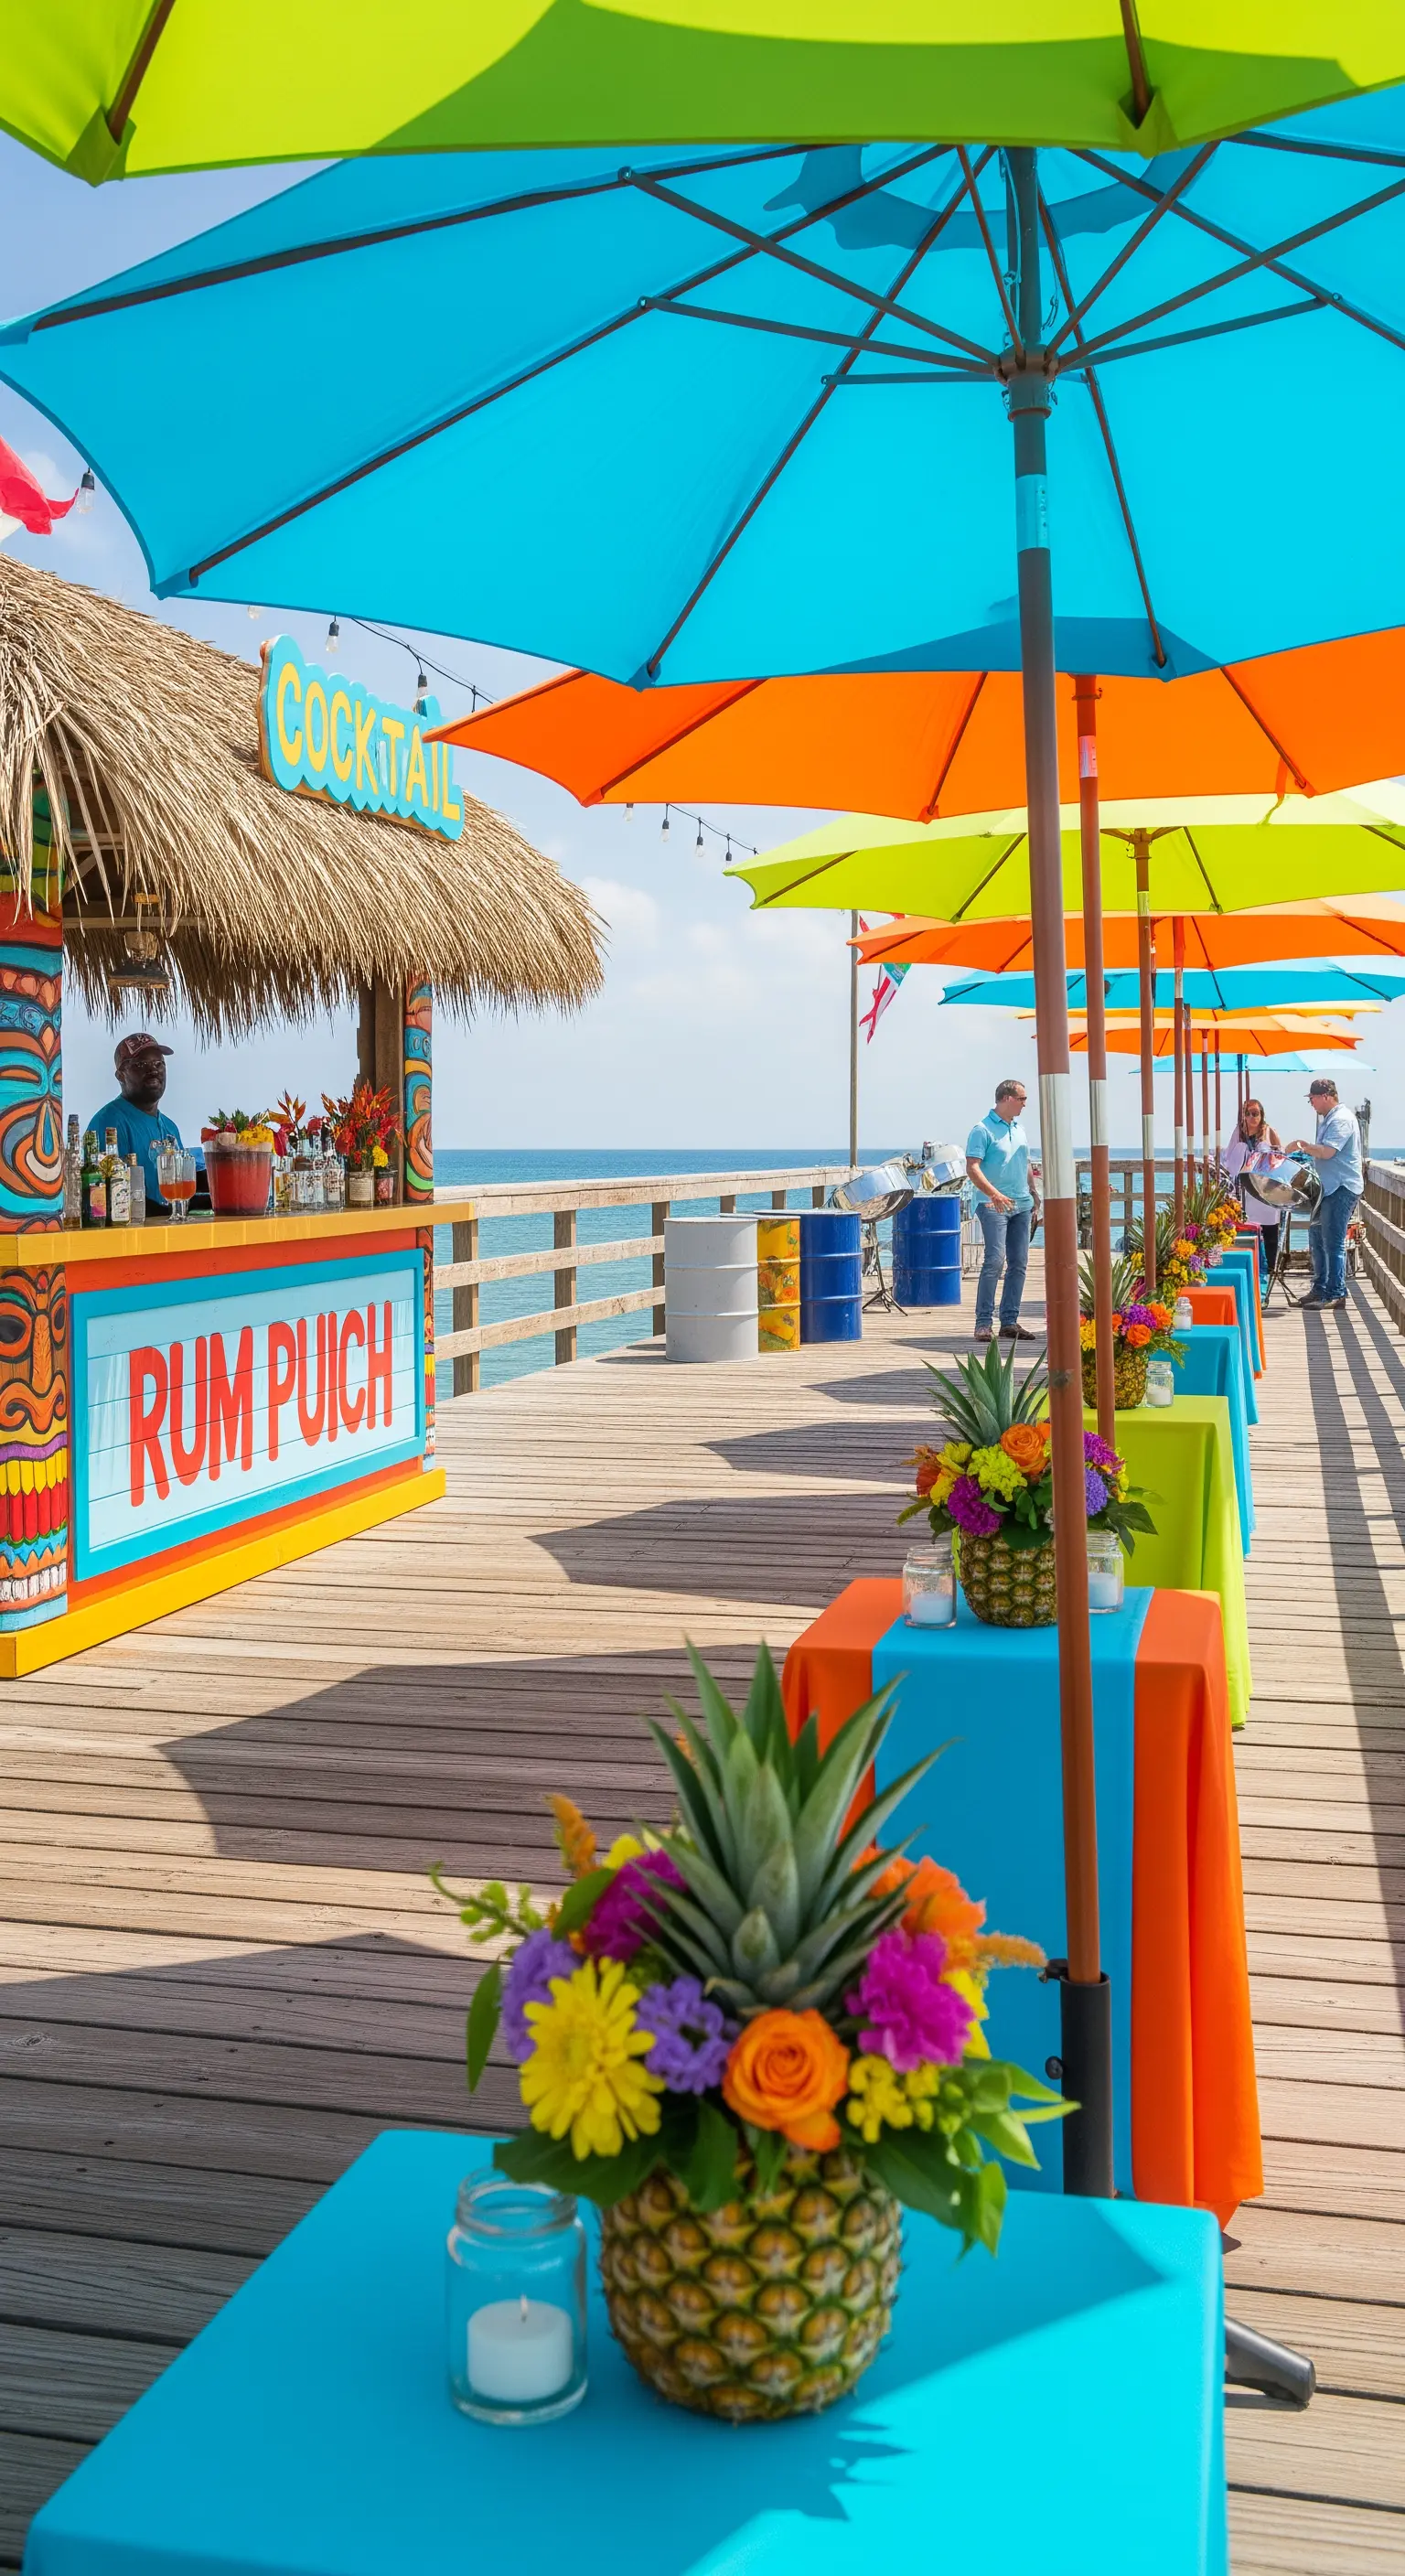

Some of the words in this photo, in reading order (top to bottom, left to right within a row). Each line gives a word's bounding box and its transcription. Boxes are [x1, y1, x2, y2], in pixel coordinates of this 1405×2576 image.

[277, 662, 459, 821] COCKTAIL
[129, 1326, 252, 1507] RUM
[268, 1301, 392, 1461] PUICH
